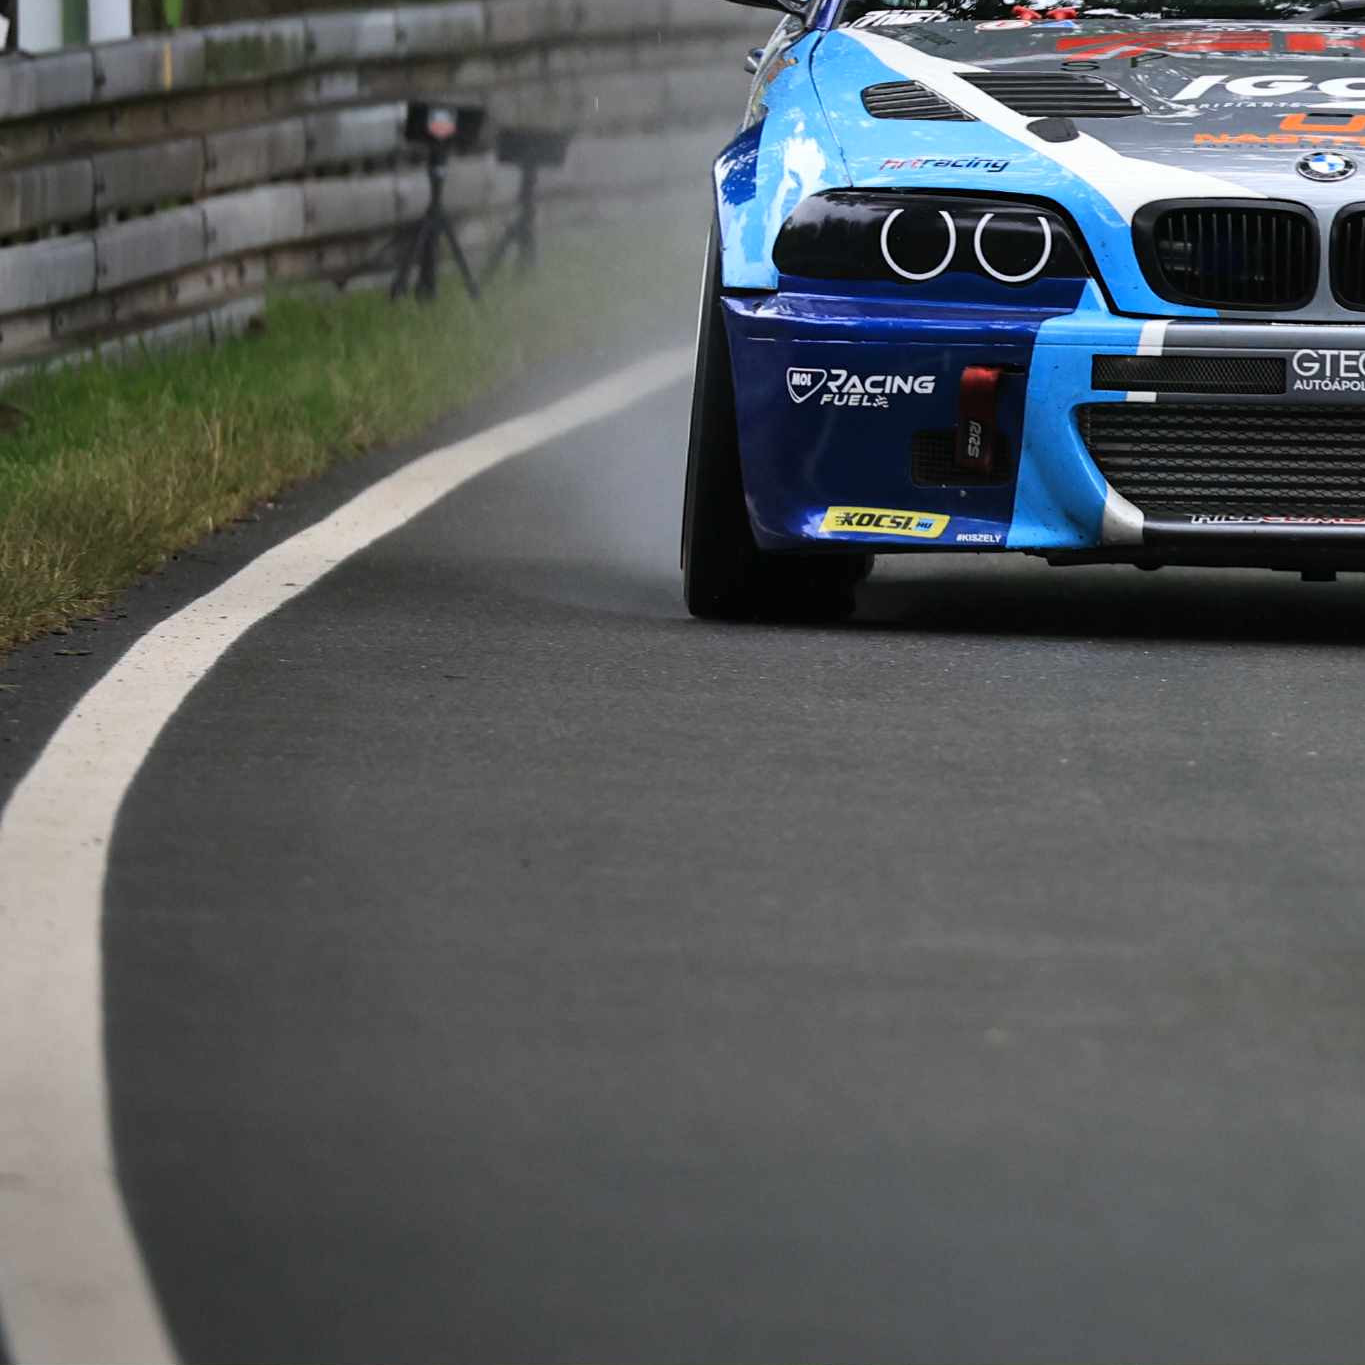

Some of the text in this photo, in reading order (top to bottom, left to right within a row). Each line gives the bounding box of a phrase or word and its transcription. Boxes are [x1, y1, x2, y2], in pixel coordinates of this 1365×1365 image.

[791, 368, 936, 394] MOL RACING
[820, 394, 873, 406] FUEL
